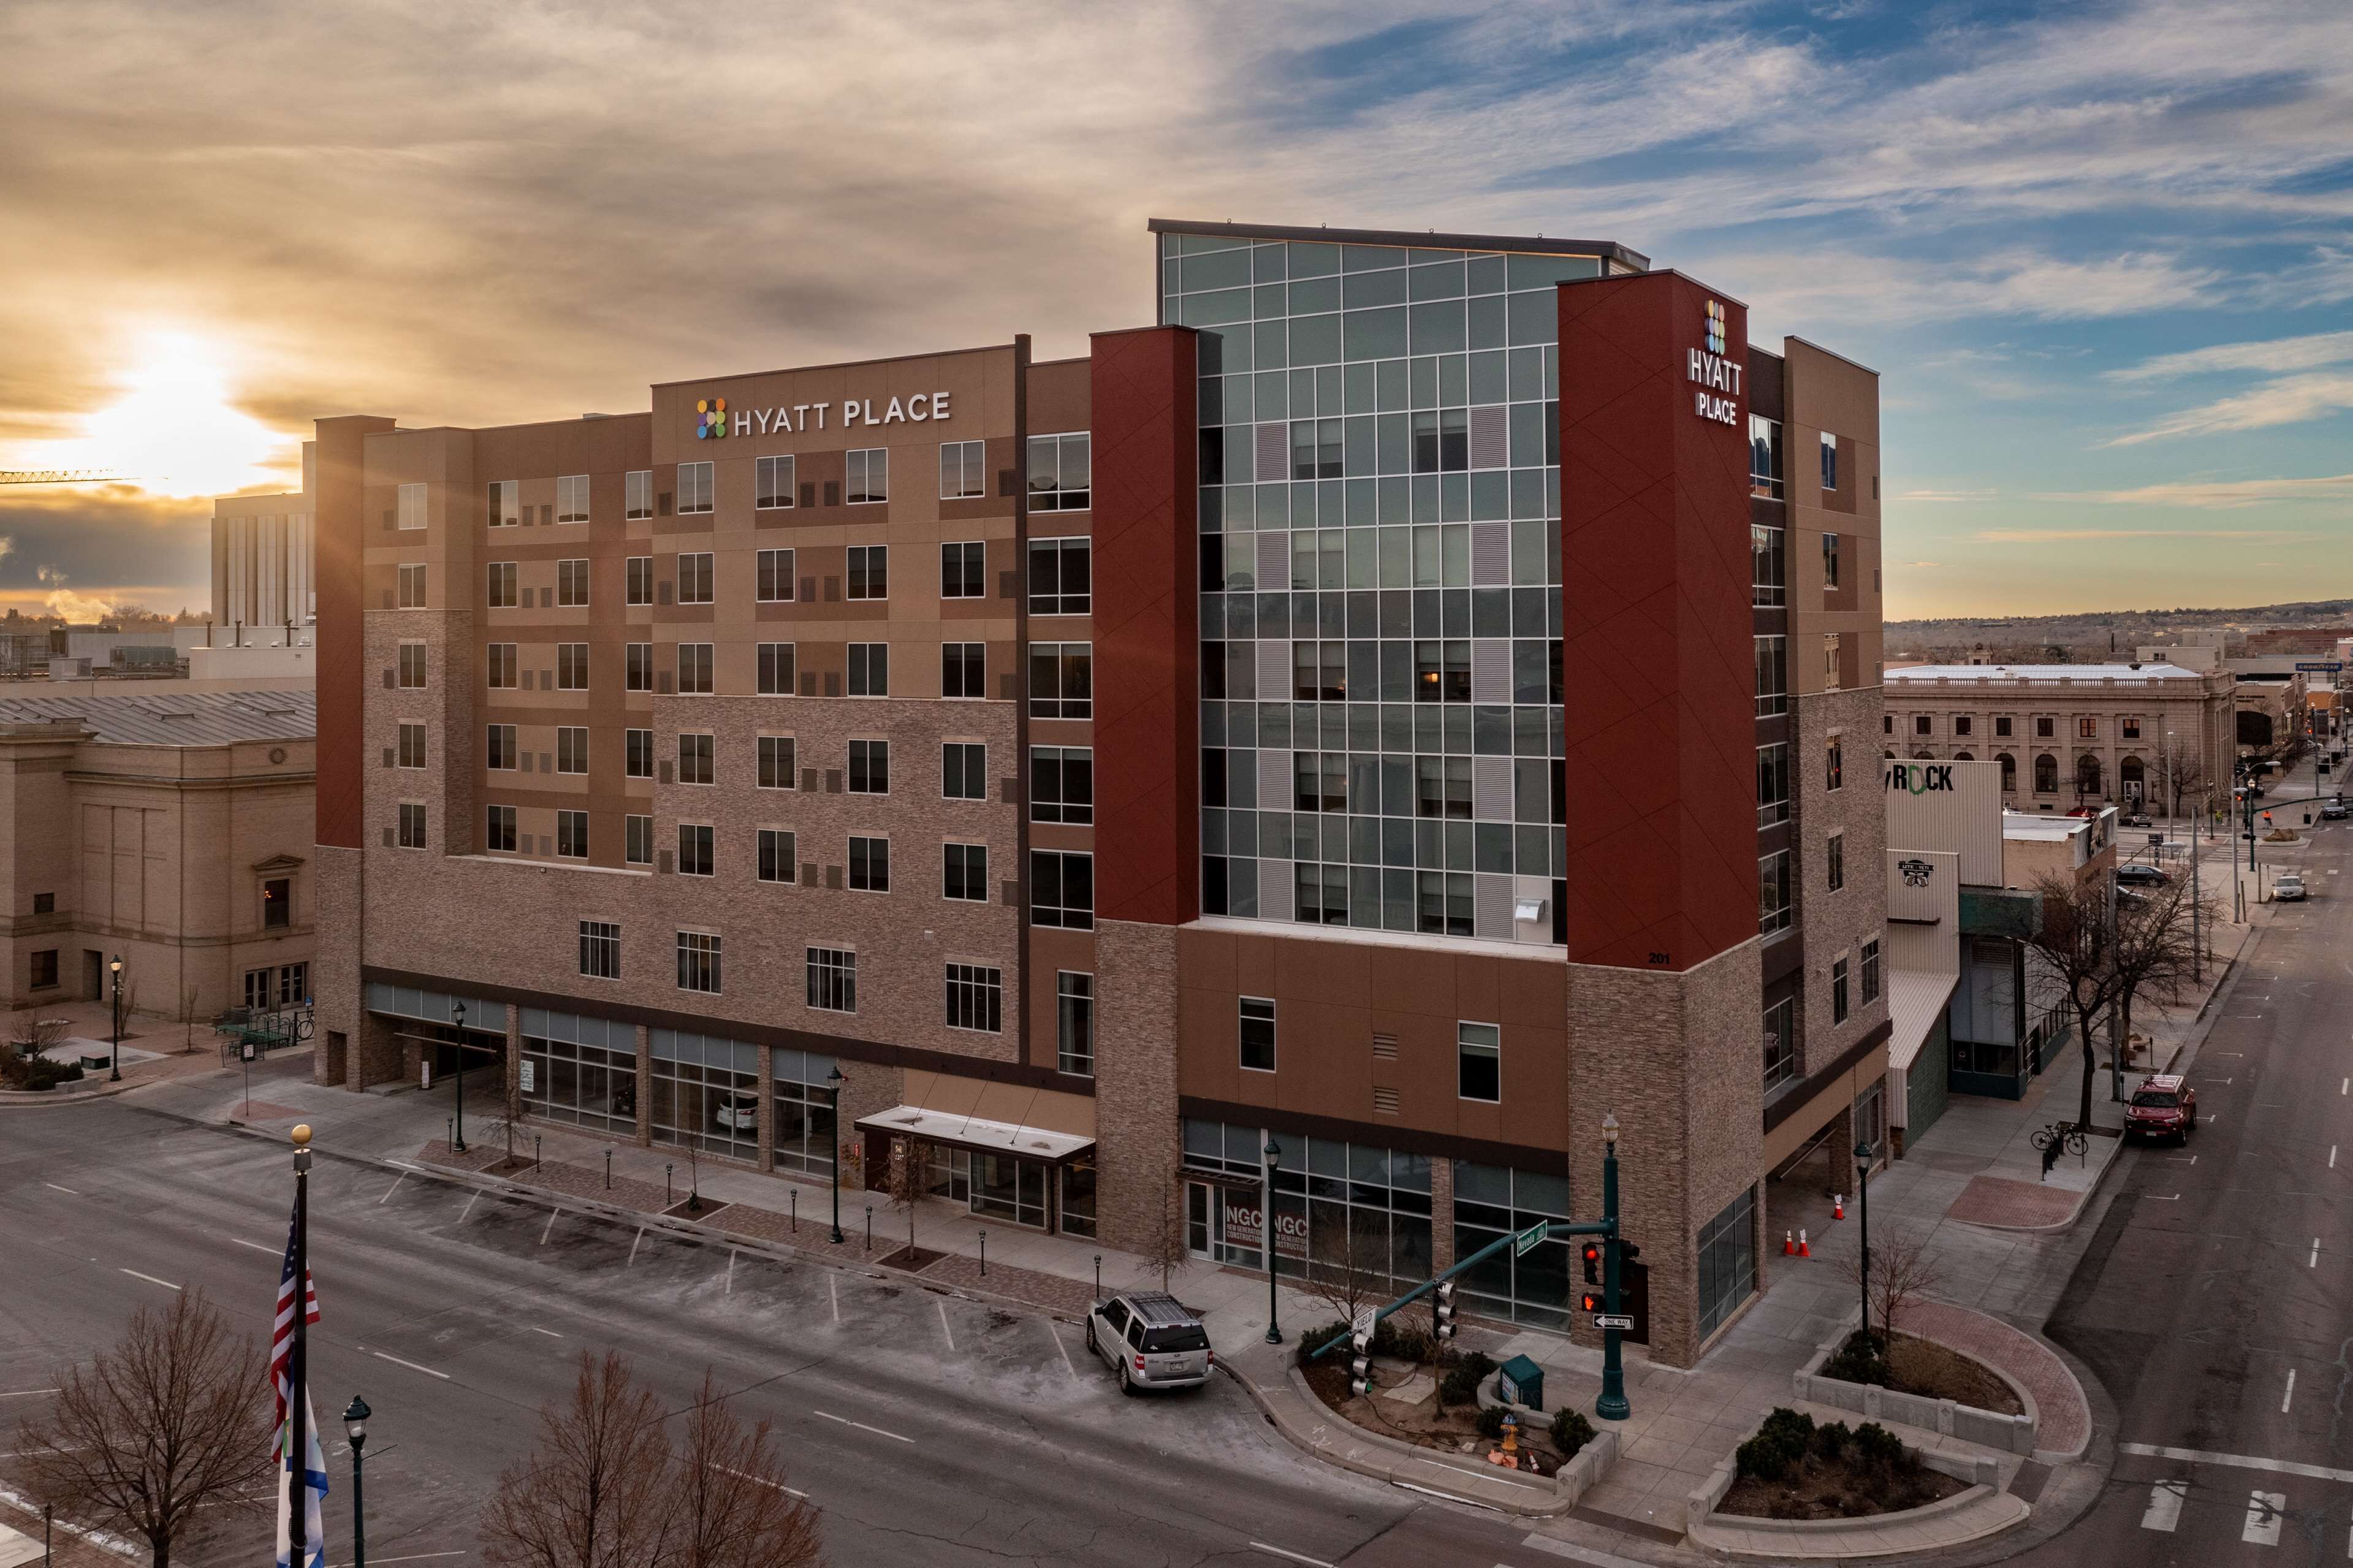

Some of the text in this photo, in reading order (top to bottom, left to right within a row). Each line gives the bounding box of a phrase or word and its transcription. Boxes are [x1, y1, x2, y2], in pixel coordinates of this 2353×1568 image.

[1687, 348, 1741, 395] HYATT
[735, 391, 951, 436] HYATT PLACE
[1695, 392, 1736, 425] PLACE
[1648, 952, 1670, 965] 201
[1226, 1205, 1262, 1228] NGC
[1519, 1233, 1535, 1252] Nevada
[1356, 1312, 1372, 1329] YIELD
